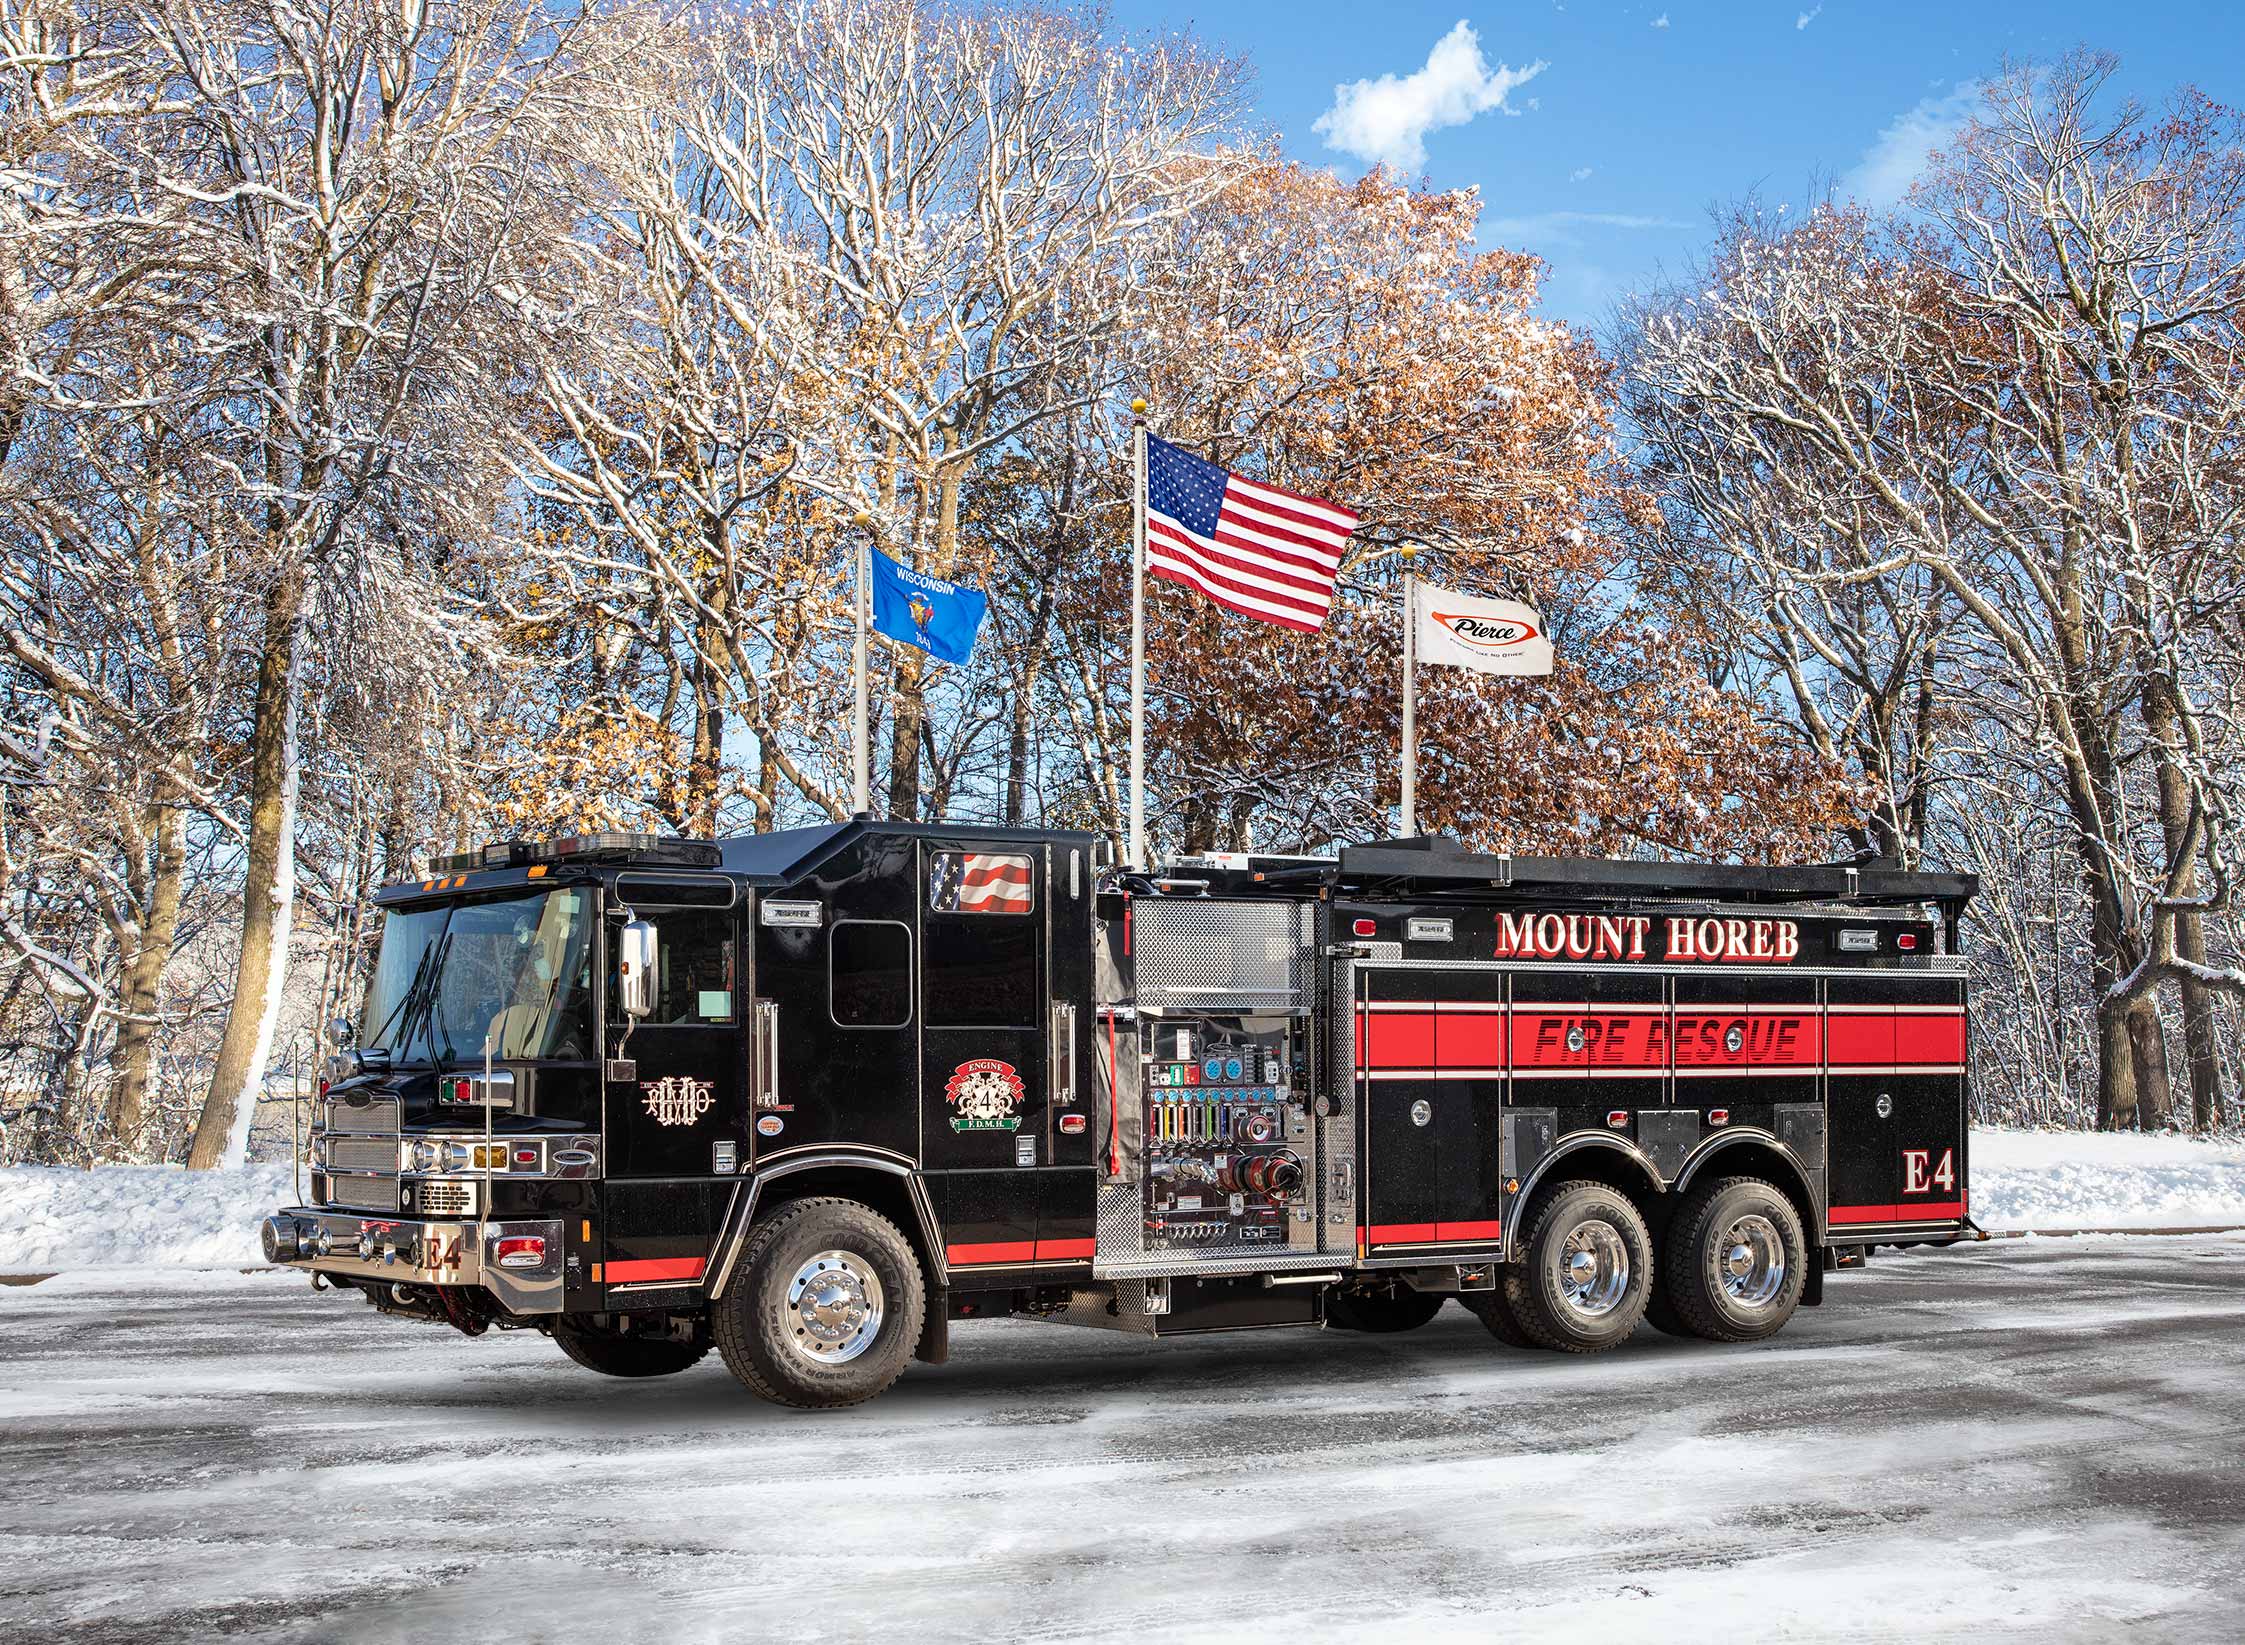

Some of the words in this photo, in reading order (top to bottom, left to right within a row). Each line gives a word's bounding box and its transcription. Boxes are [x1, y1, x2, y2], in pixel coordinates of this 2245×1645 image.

[896, 566, 955, 596] WISCONSIN
[1454, 618, 1516, 639] Pierce
[1494, 912, 1650, 962] MOUNT
[1664, 917, 1799, 964] HOREB
[1533, 1019, 1630, 1062] FIRE
[1643, 1019, 1800, 1062] RESCUE
[968, 1061, 1003, 1072] ENGINE
[980, 1090, 991, 1112] 4
[1902, 1147, 1955, 1195] E4
[424, 1234, 461, 1270] E4
[1585, 1205, 1641, 1292] GOODYEAR
[1708, 1230, 1719, 1264] RSD
[1764, 1204, 1797, 1309] GOODYEAR
[1546, 1266, 1558, 1301] RSD
[770, 1304, 782, 1338] MSA
[777, 1341, 803, 1369] MAX
[806, 1368, 858, 1381] ARMOR
